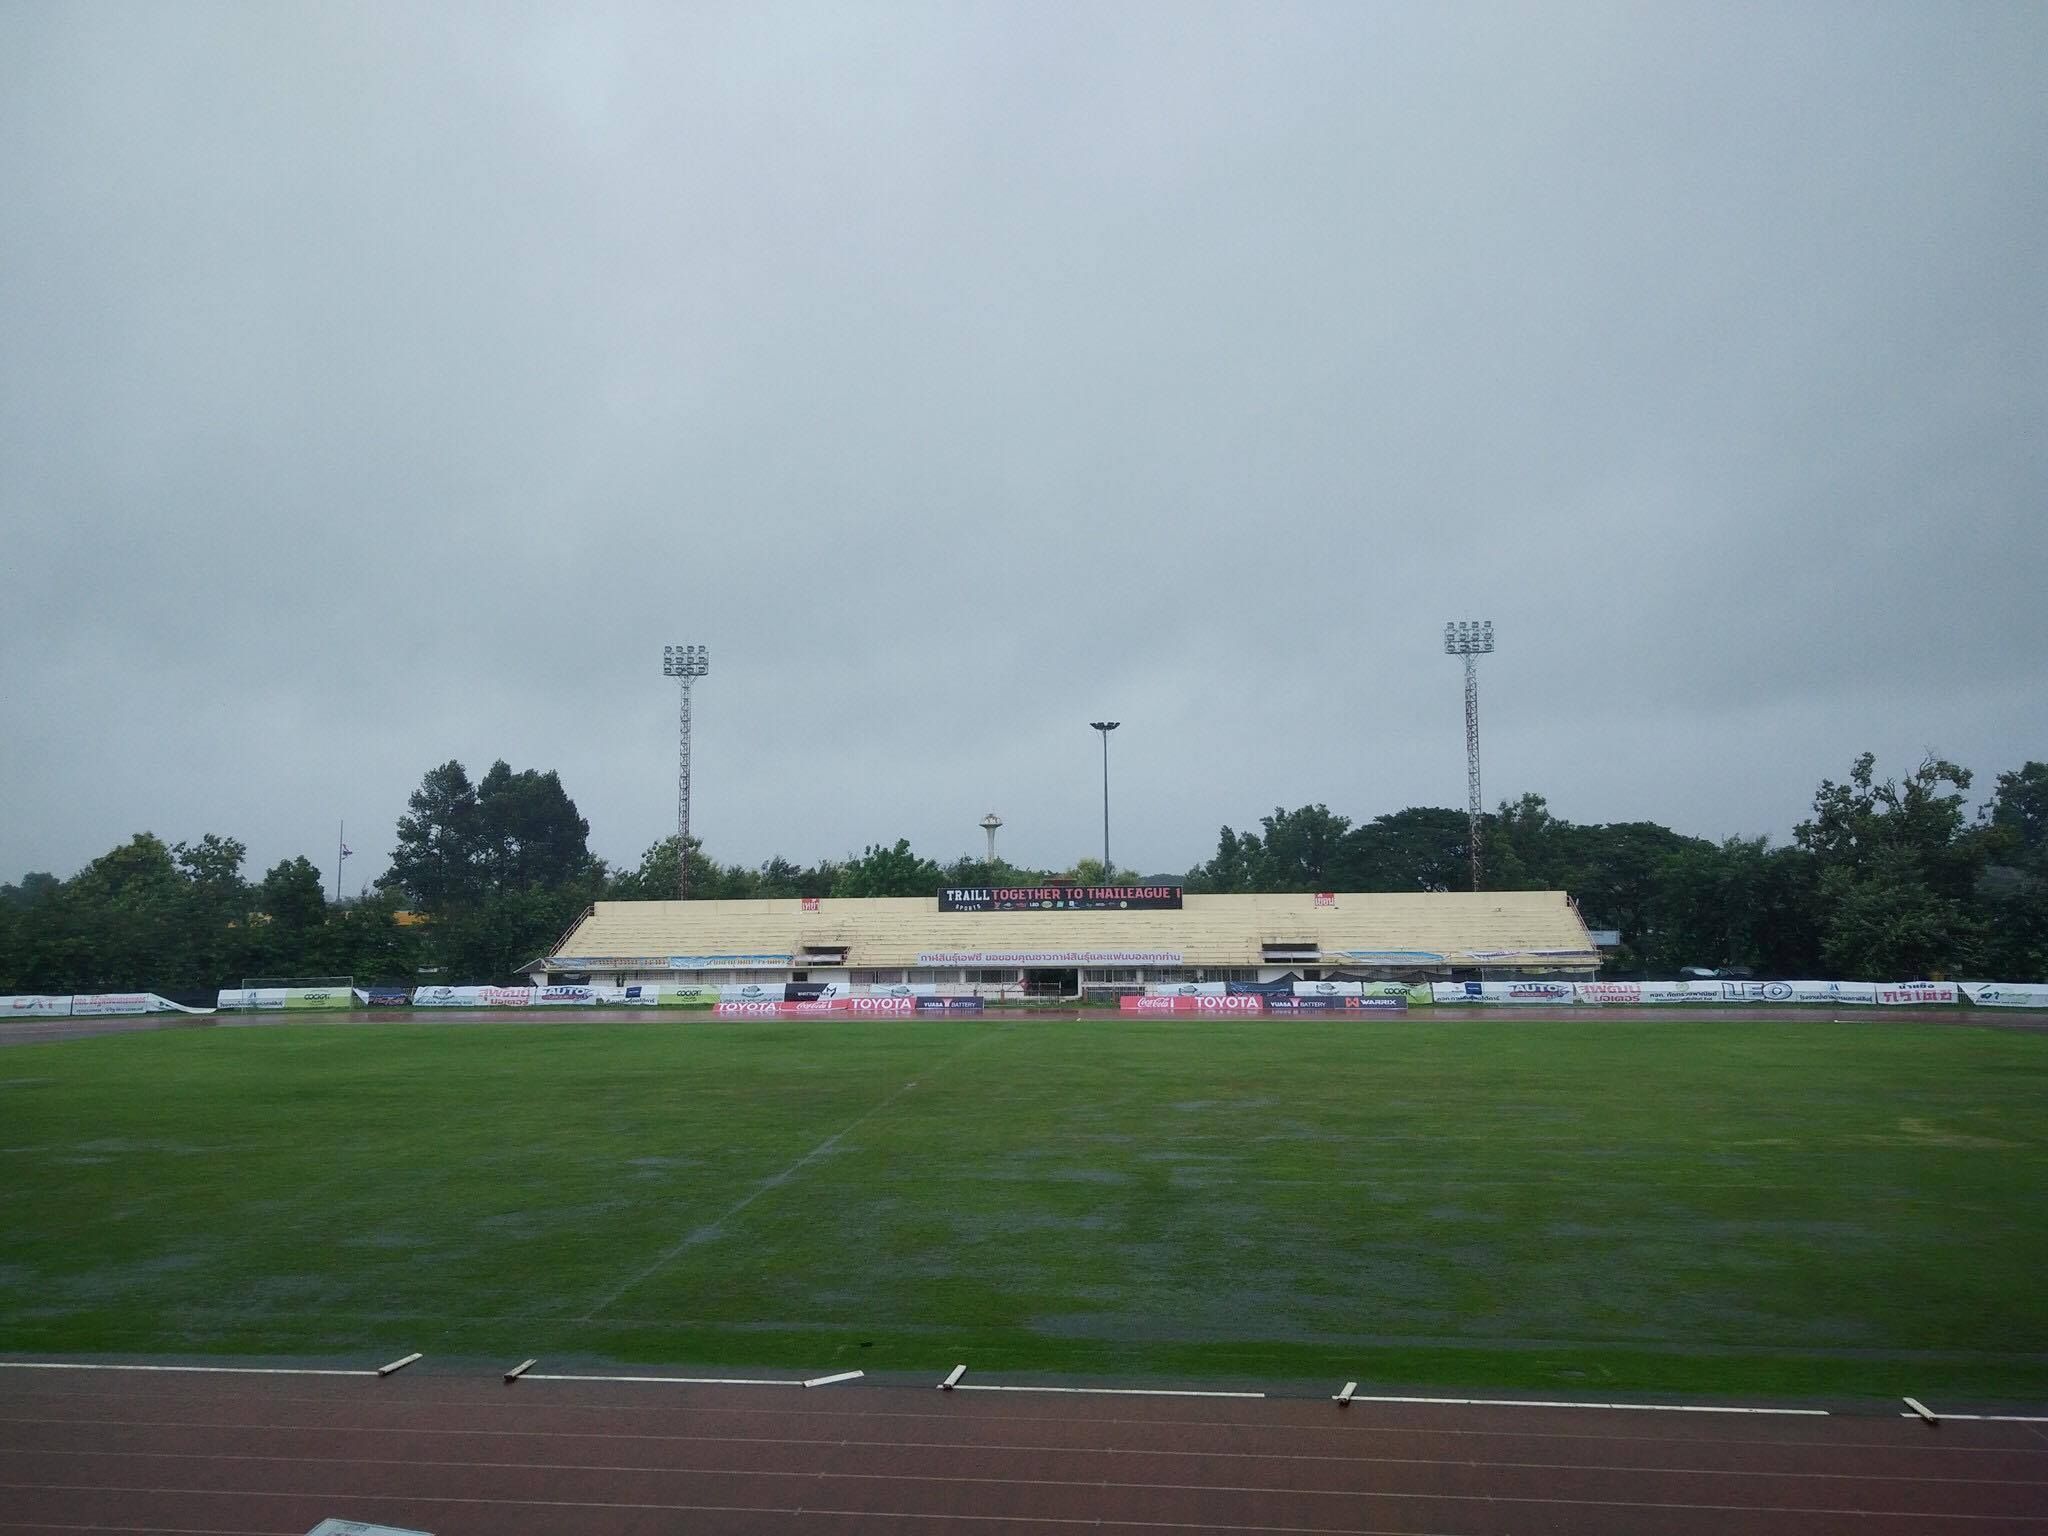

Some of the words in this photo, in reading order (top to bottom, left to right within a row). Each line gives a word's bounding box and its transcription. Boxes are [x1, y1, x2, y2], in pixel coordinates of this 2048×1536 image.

[947, 890, 990, 901] TRAILL
[991, 889, 1060, 900] TOGETHER
[1066, 889, 1083, 899] TO
[1087, 888, 1170, 899] THAILEAGUE
[1175, 888, 1180, 897] 1
[548, 987, 585, 995] AUTO
[1514, 984, 1558, 992] AUTO
[1722, 981, 1793, 1001] LEO
[719, 1002, 777, 1011] TOYOTA
[851, 998, 912, 1009] TOYOTA
[1194, 996, 1259, 1008] TOYOTA
